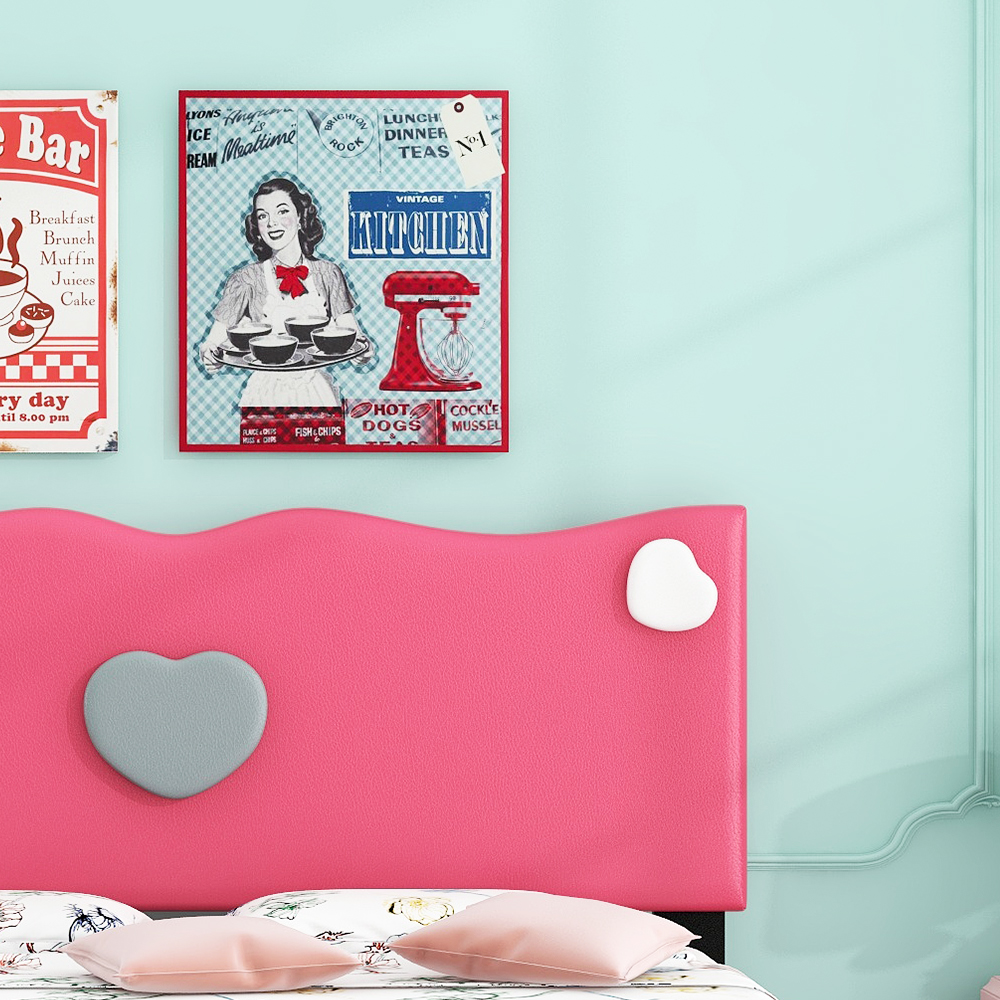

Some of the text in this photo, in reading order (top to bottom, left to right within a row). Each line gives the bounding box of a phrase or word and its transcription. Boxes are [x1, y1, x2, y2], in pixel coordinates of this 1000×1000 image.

[186, 109, 221, 120] LYONS
[324, 113, 368, 131] BRIGHTON
[383, 113, 442, 125] LUNCH
[250, 120, 266, 133] is
[187, 128, 212, 141] ICE
[16, 113, 91, 174] Bar
[329, 136, 364, 152] ROCK
[398, 144, 450, 159] TEAS
[187, 152, 217, 169] REAM
[396, 195, 445, 203] VINTAGE
[29, 210, 96, 225] Breakfast
[43, 230, 95, 245] Brunch
[350, 211, 489, 255] KITCHEN
[40, 251, 95, 266] Muffin
[51, 271, 96, 286] Juices
[60, 291, 96, 307] Cake
[28, 392, 70, 411] day
[373, 404, 411, 416] HOT
[450, 404, 501, 417] COCKLE
[19, 413, 46, 422] 8.00
[49, 415, 70, 424] pm
[362, 420, 422, 432] DOGS
[452, 420, 501, 432] MUSSEL
[295, 427, 313, 437] FISH
[318, 426, 342, 436] CHIPS
